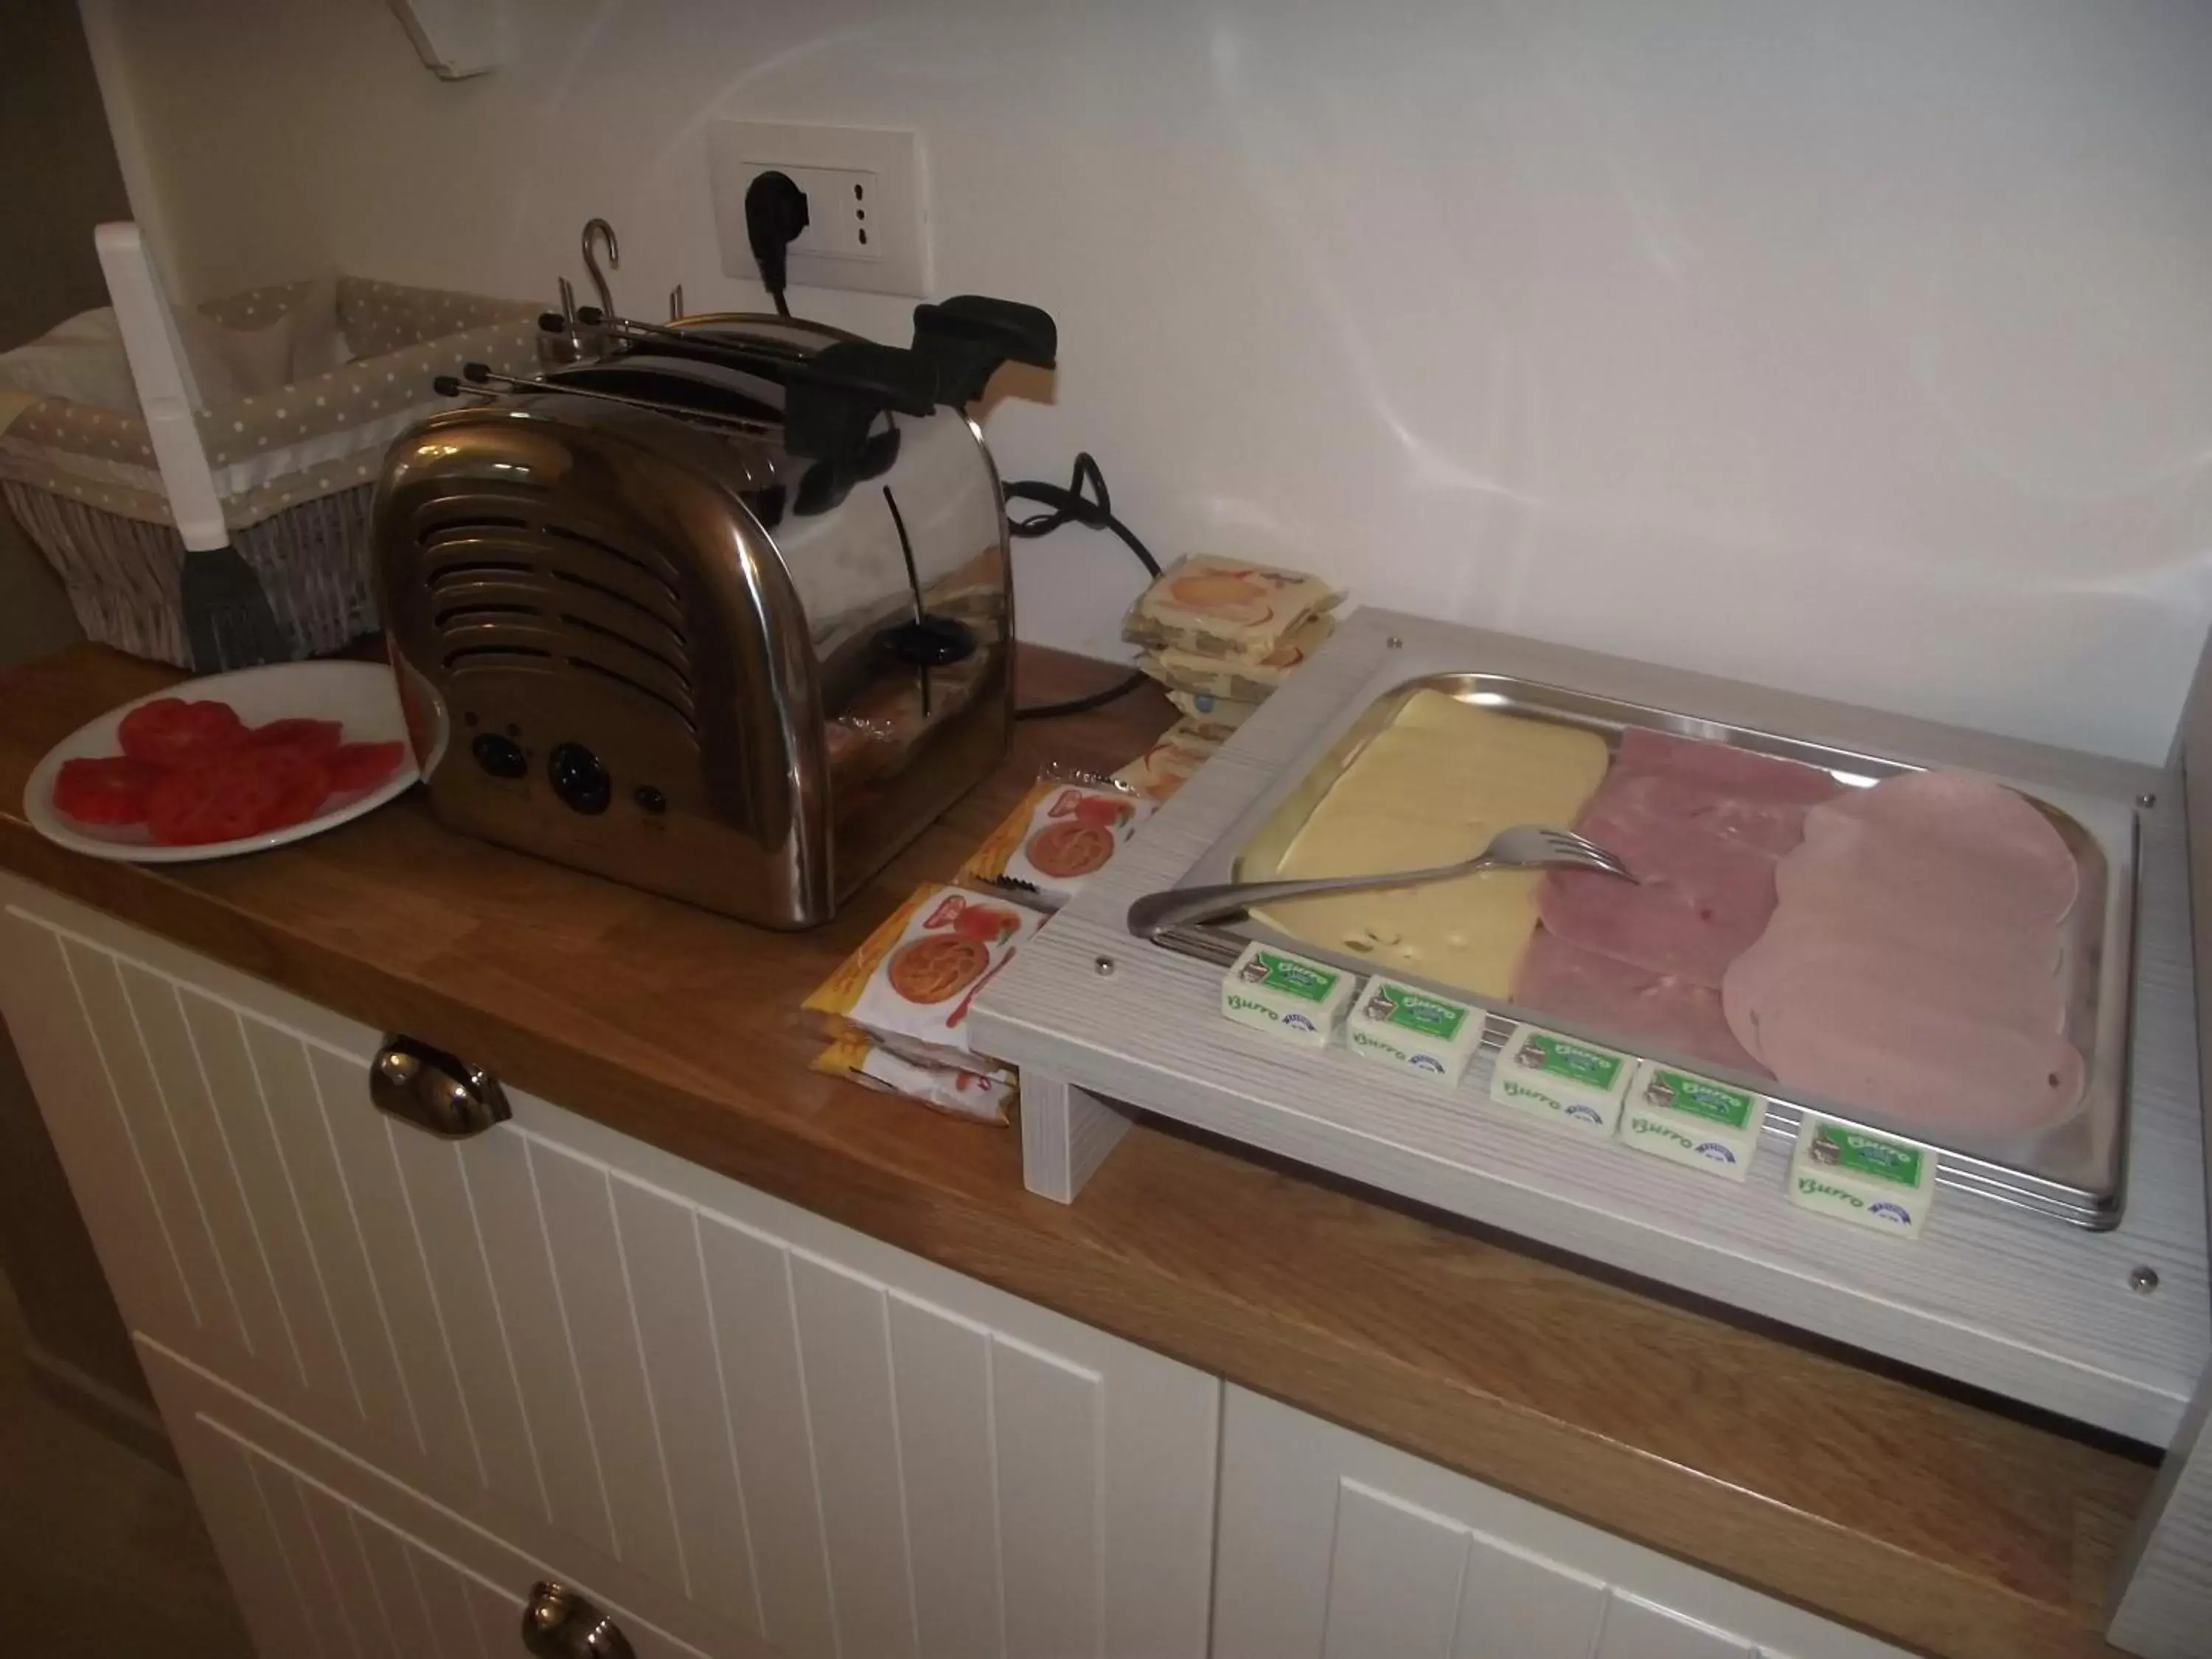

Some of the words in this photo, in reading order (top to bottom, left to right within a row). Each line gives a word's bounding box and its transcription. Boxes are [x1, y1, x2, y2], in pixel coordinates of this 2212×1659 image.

[1228, 995, 1279, 1020] Burro
[1354, 1033, 1406, 1060] Burro
[1504, 1081, 1561, 1110] Burro
[1632, 1118, 1692, 1149] Burro
[1799, 1178, 1863, 1208] Burro
